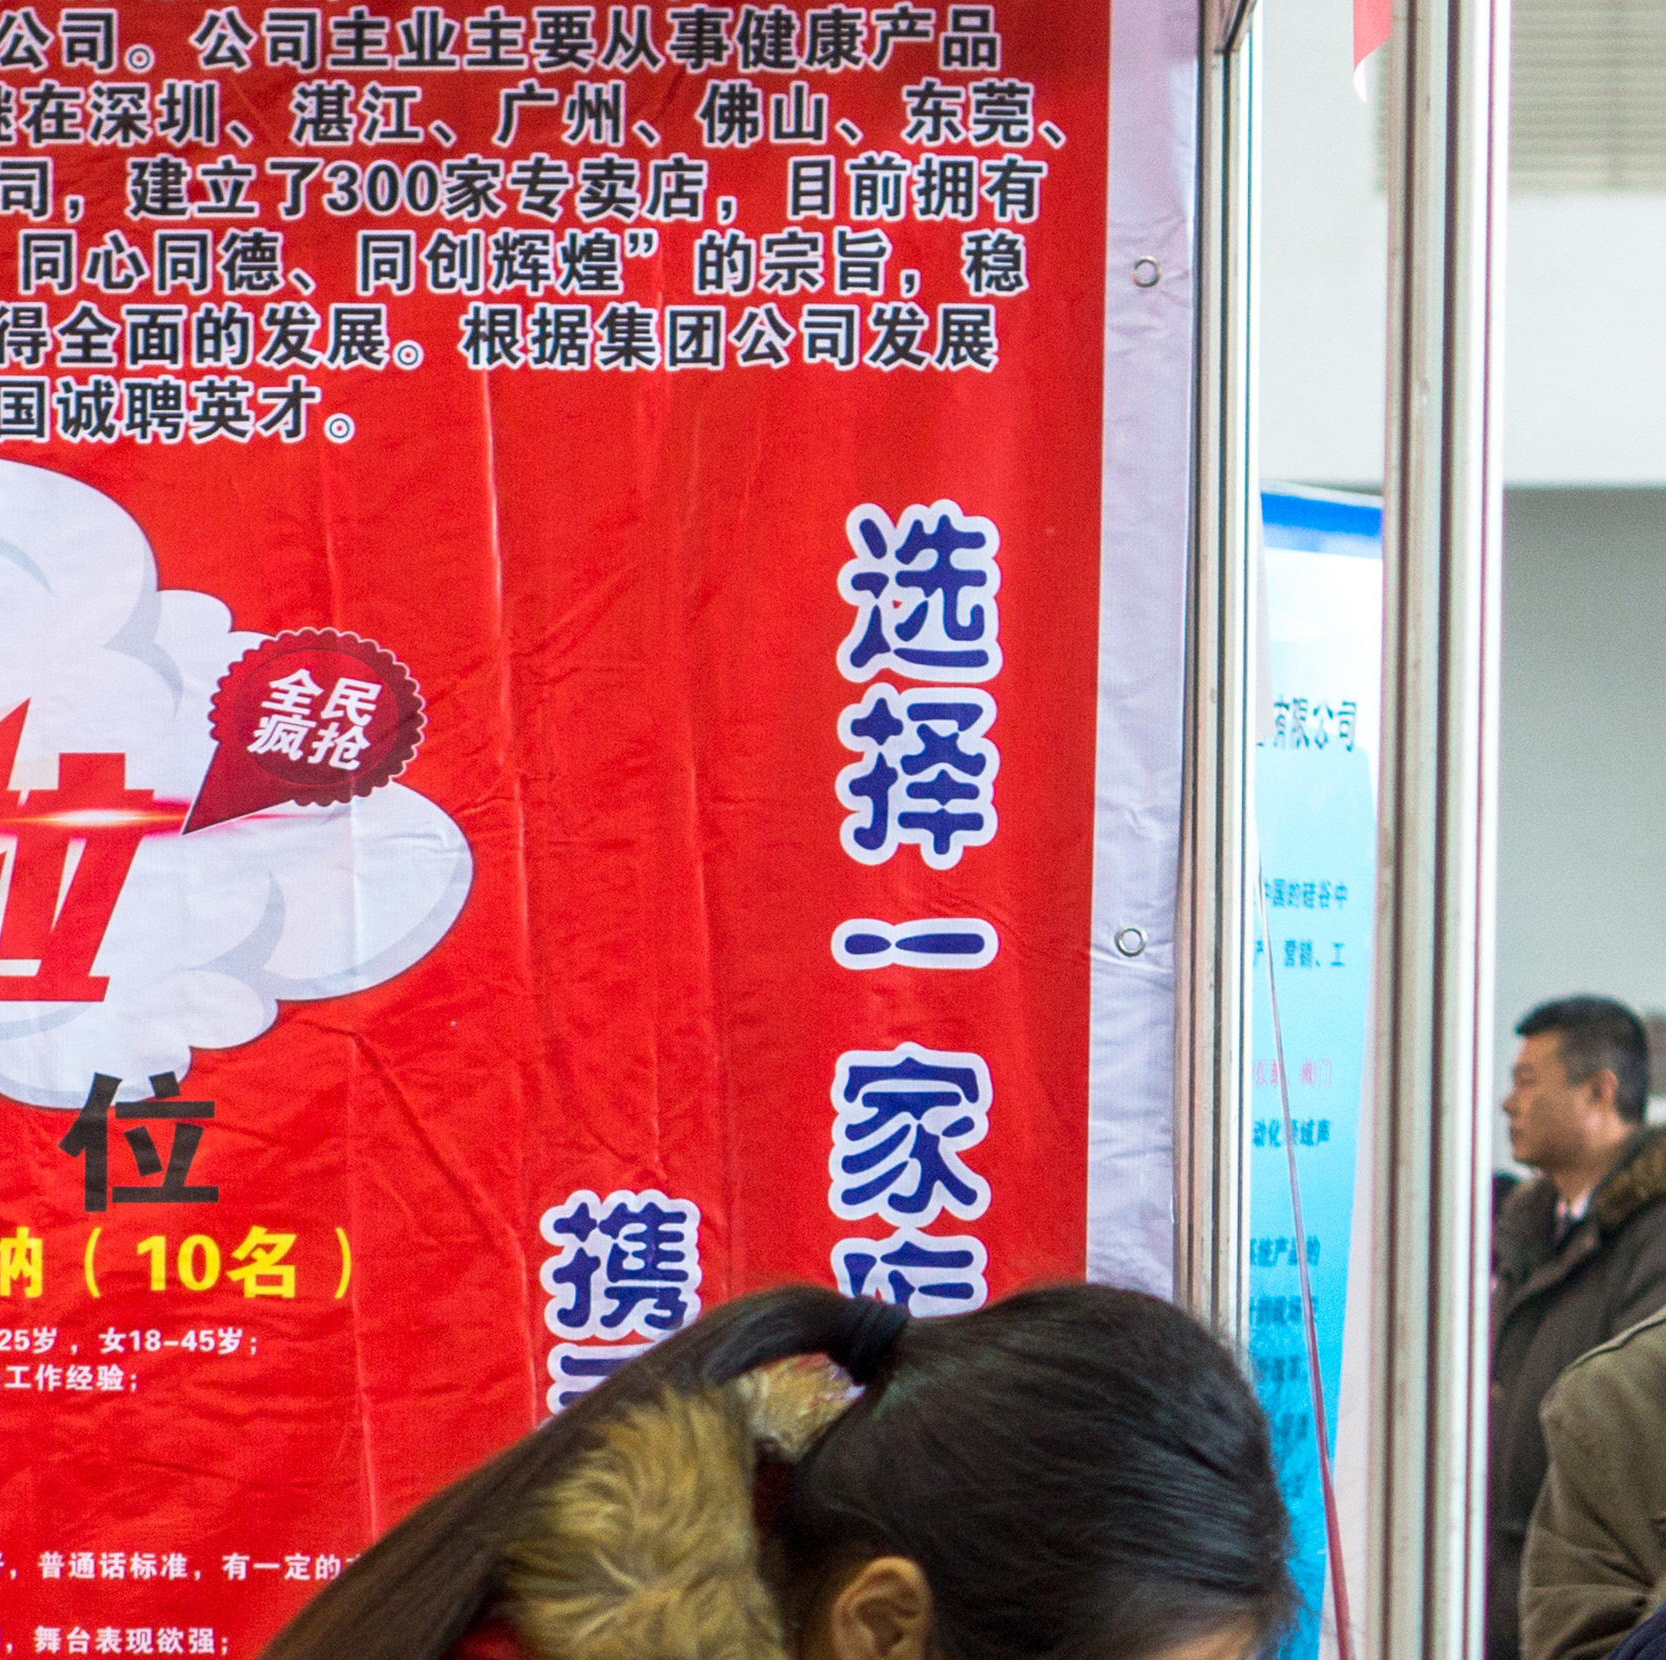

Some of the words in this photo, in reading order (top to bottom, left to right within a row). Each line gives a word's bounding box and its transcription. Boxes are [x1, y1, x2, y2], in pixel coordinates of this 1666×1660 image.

[259, 667, 383, 728] 全民
[1255, 694, 1358, 753] 有限公司
[246, 713, 372, 772] 疯抢
